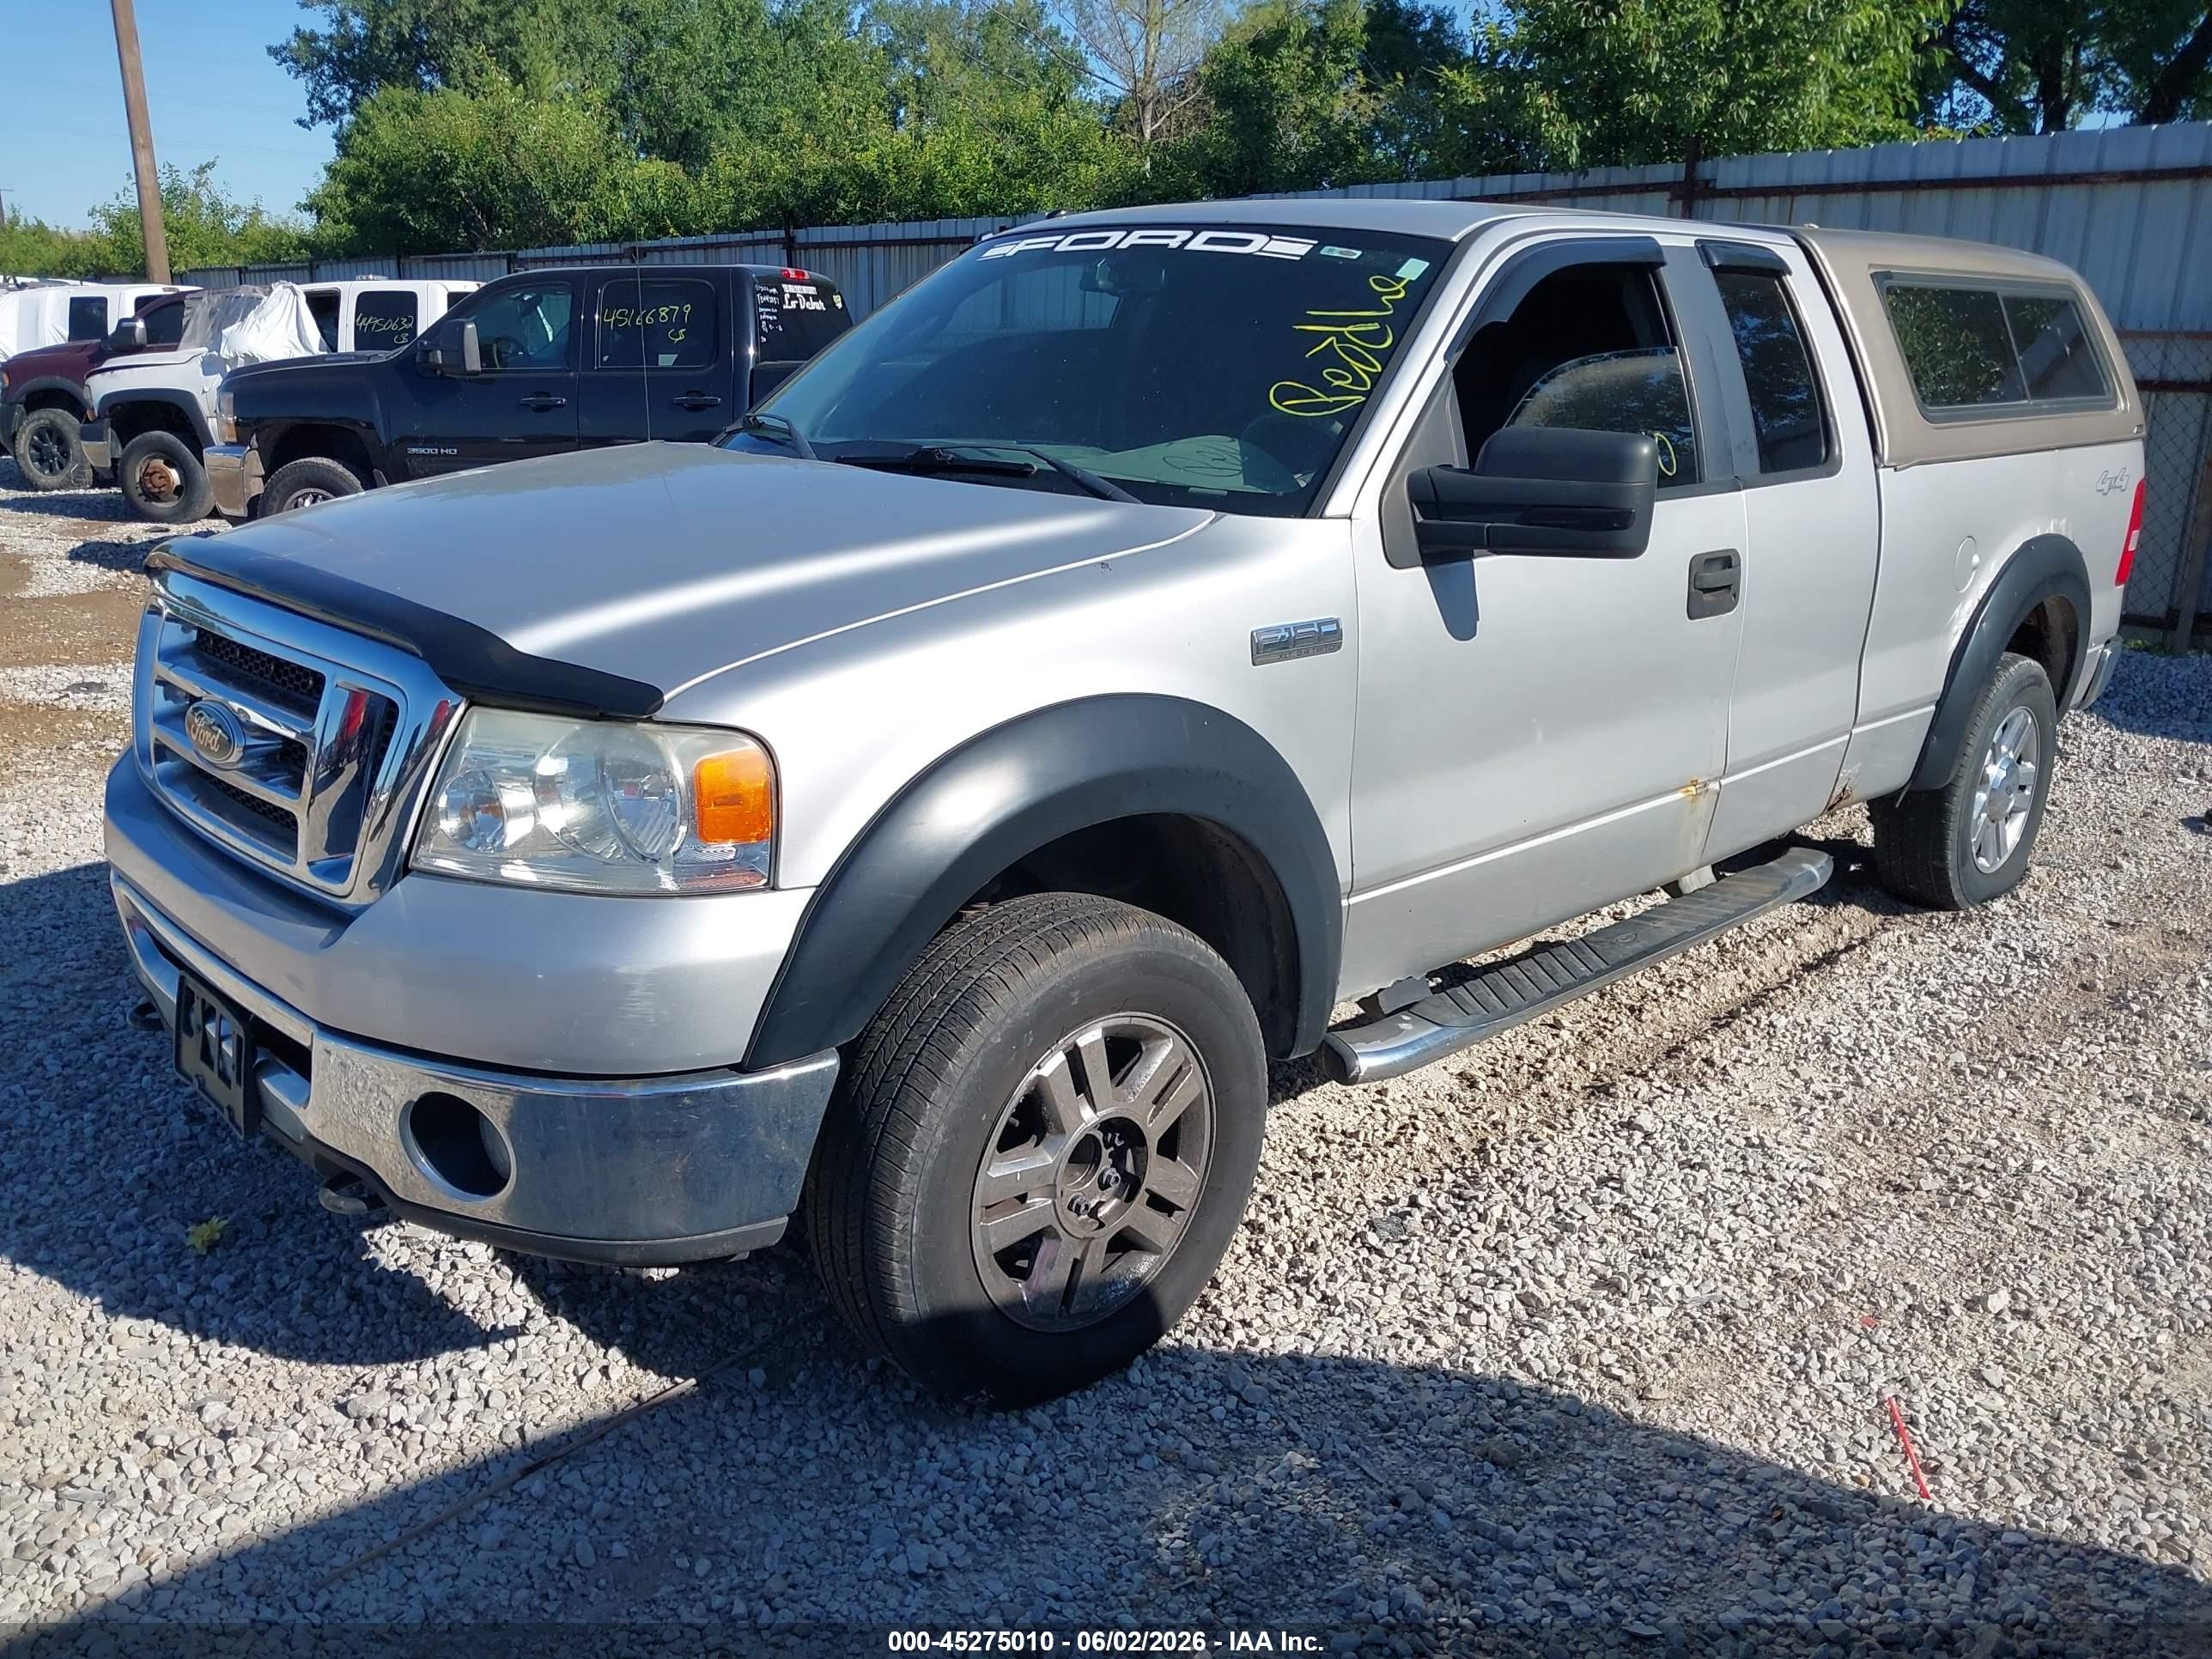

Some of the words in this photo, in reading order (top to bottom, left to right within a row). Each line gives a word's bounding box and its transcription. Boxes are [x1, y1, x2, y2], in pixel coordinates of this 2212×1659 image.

[1005, 229, 1271, 257] FORD
[603, 303, 691, 331] 45166879
[2095, 467, 2130, 495] 4x4
[190, 710, 226, 752] Ford
